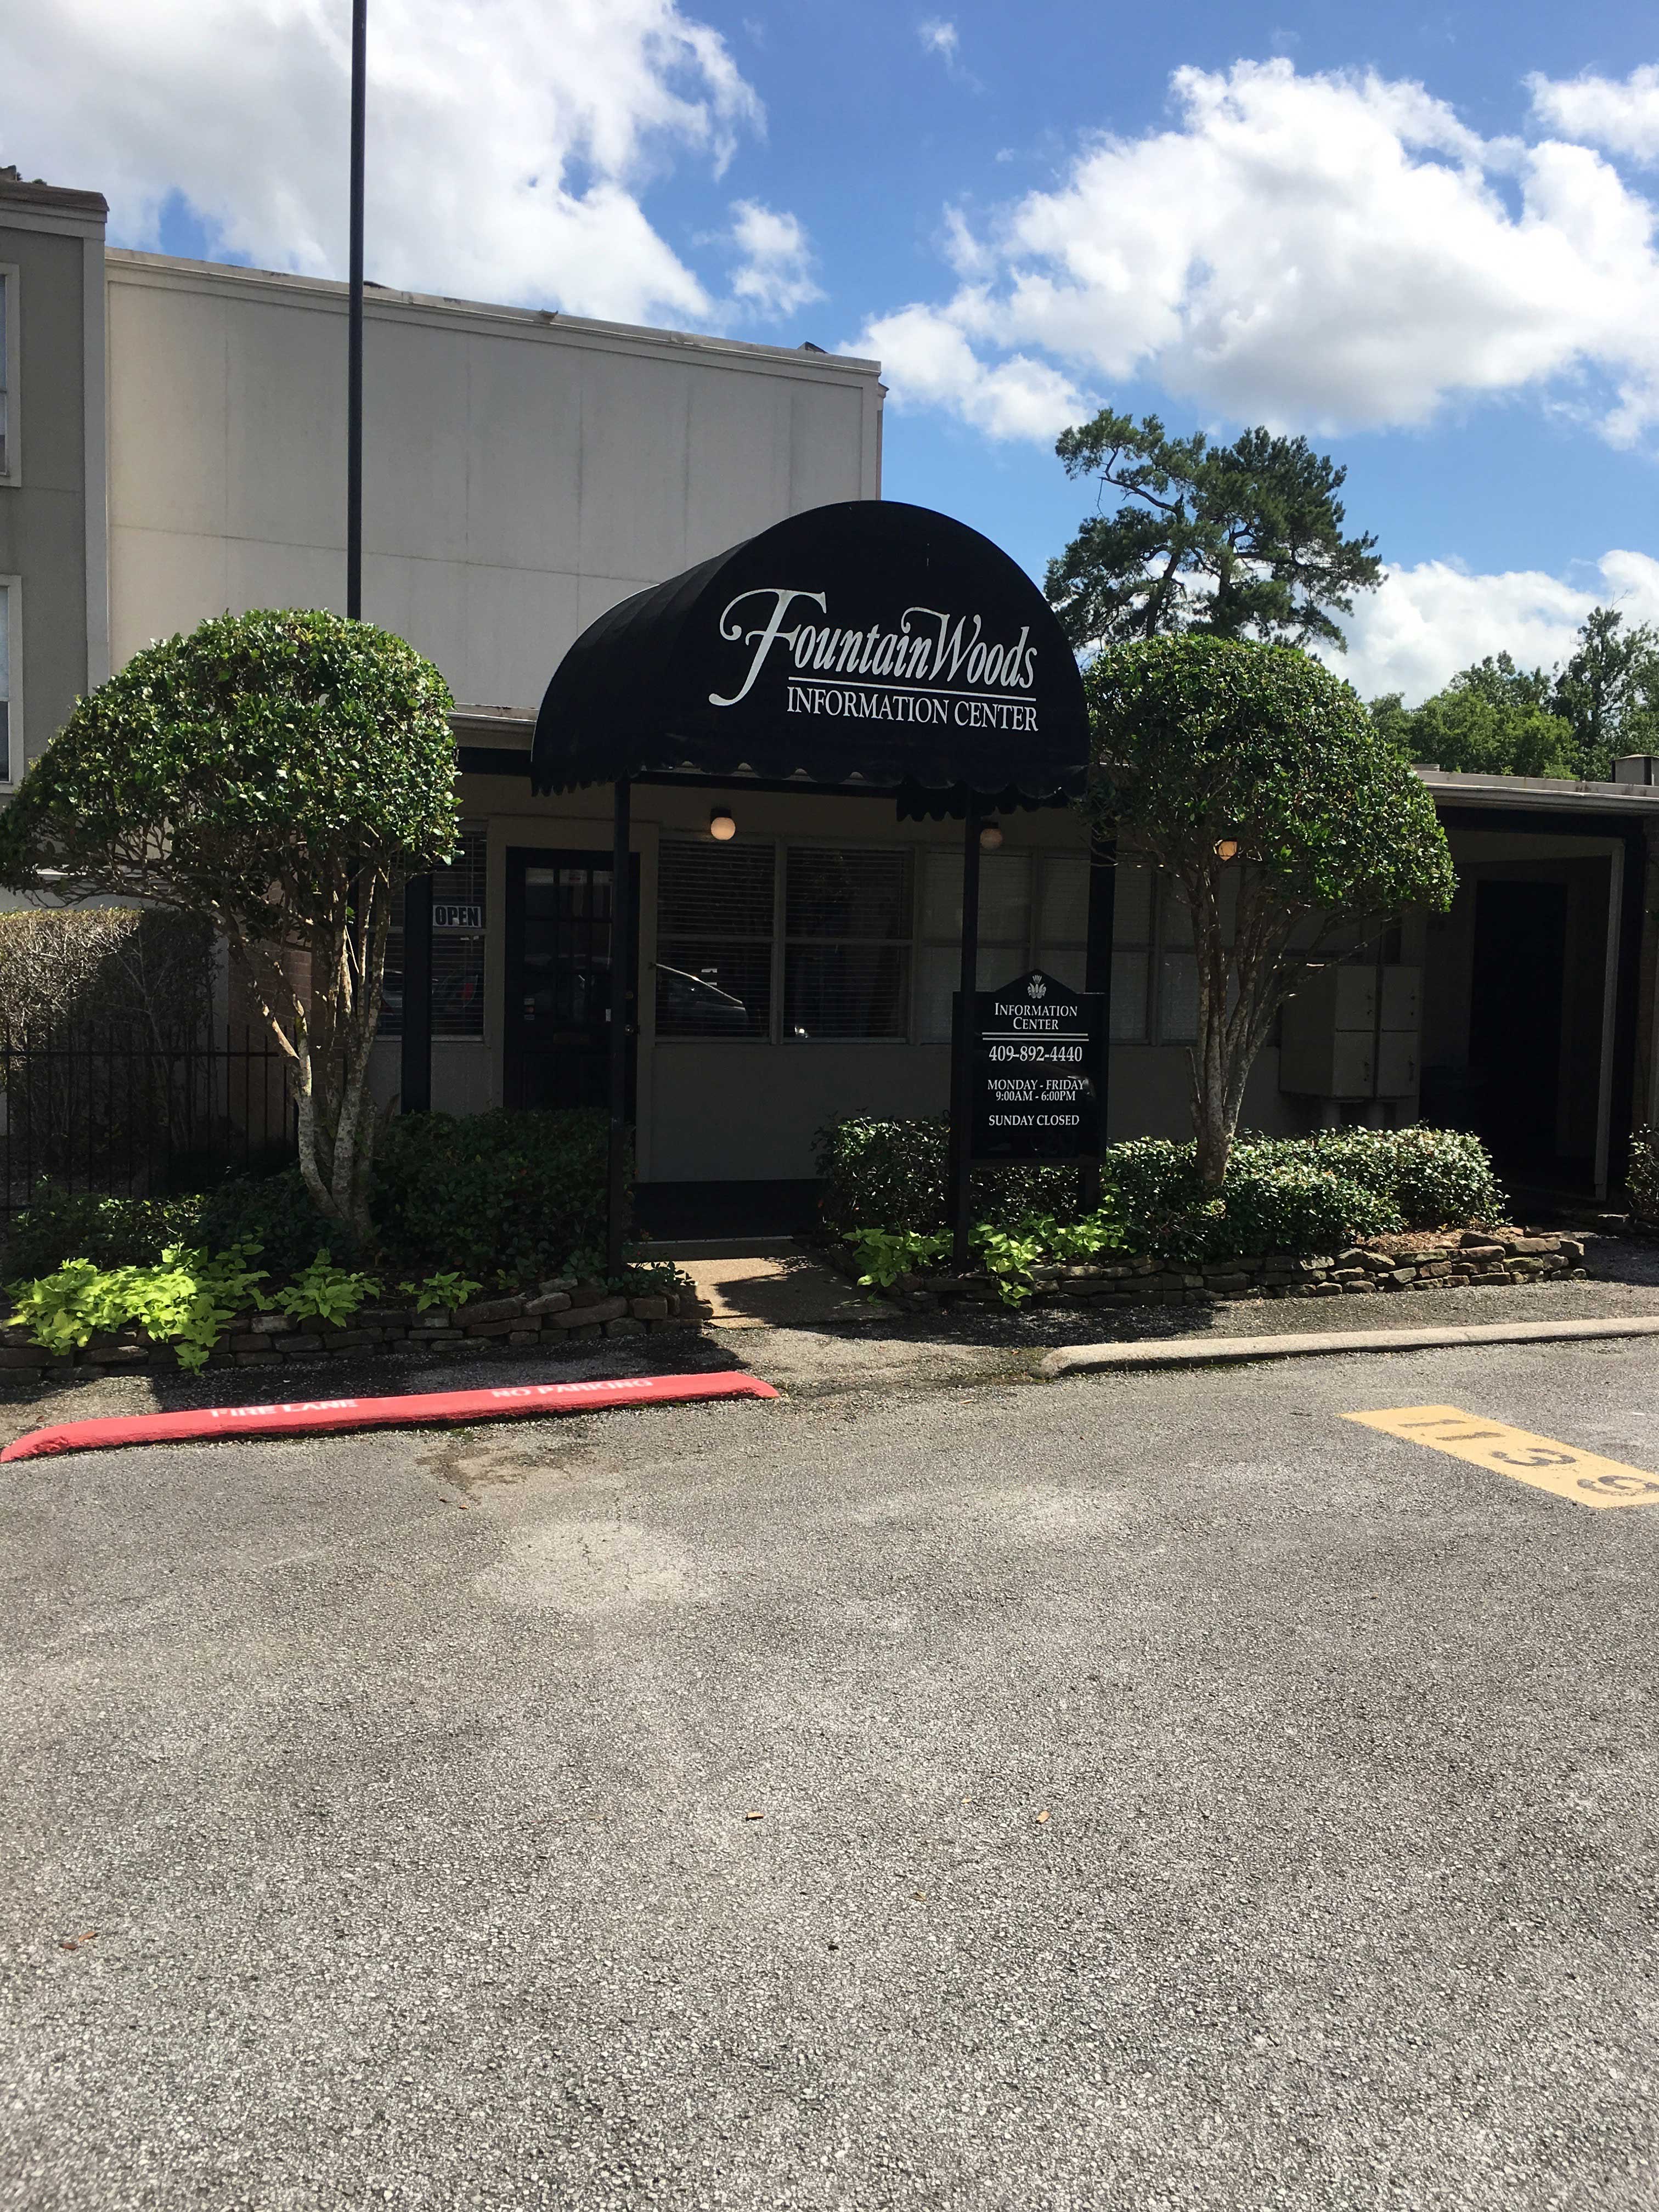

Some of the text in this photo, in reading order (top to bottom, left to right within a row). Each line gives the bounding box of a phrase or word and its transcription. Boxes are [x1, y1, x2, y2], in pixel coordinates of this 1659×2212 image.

[787, 686, 1039, 732] INFORMATION CENTER
[435, 906, 478, 926] OPEN
[989, 1046, 1082, 1062] 409-892-4440
[988, 1079, 1038, 1090] MONDAY
[1046, 1079, 1085, 1090] FRIDAY
[996, 1091, 1034, 1101] 9:00AM
[1041, 1091, 1075, 1101] 6:00PM
[989, 1115, 1080, 1126] SUNDAY CLOSED
[491, 1378, 653, 1398] NO PARKING
[211, 1400, 360, 1417] FIRE LANE
